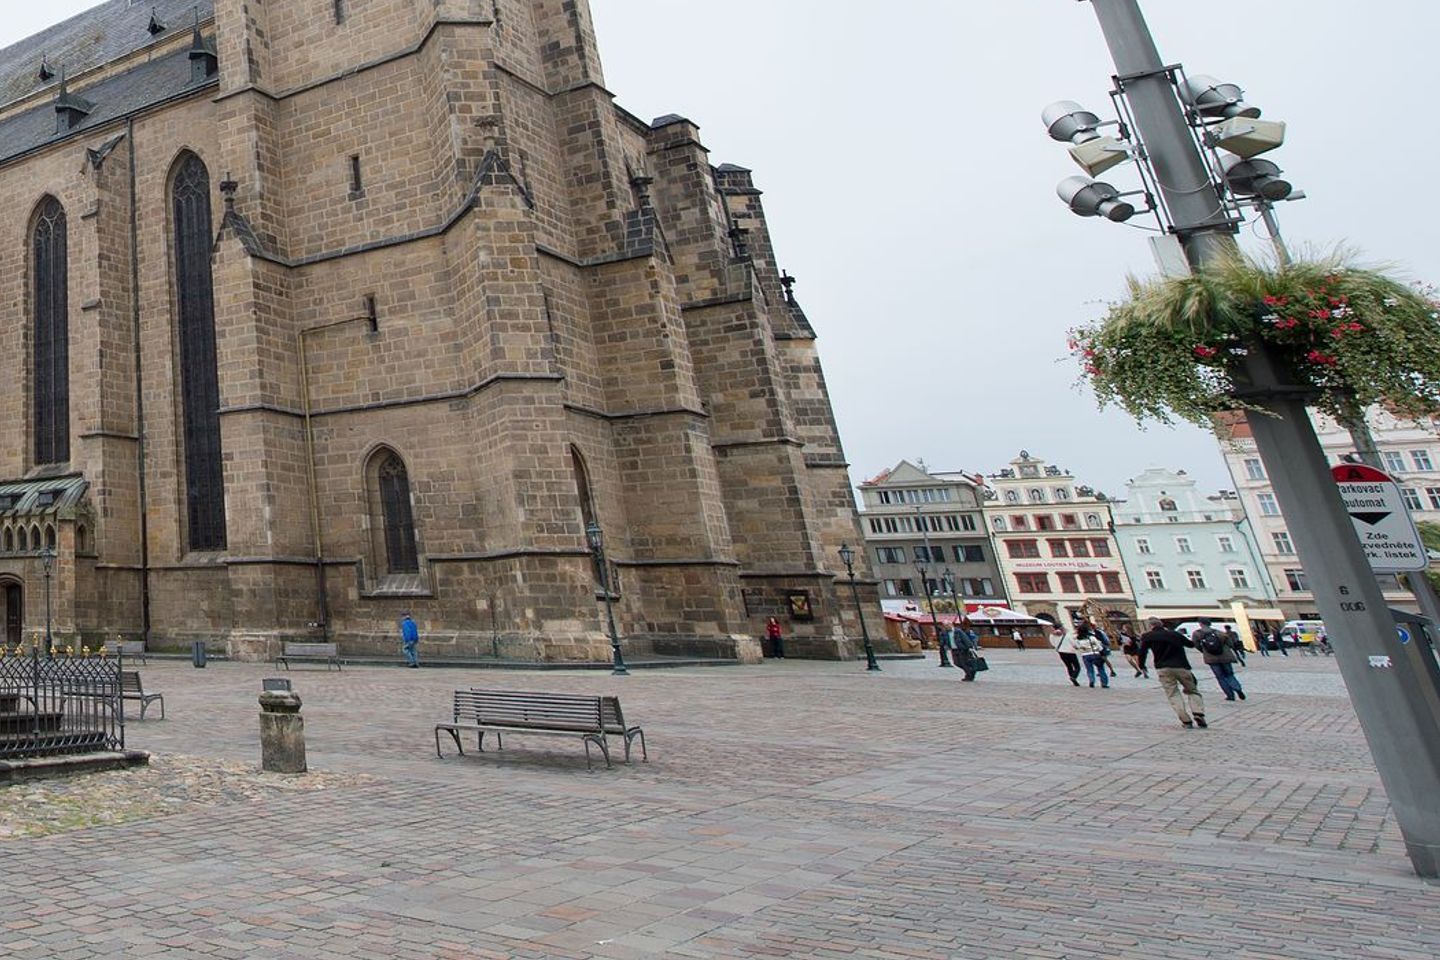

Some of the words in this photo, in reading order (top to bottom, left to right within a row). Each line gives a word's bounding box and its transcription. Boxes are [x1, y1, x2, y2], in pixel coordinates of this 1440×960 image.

[1347, 468, 1363, 479] A
[1340, 483, 1385, 494] arkovací
[1365, 532, 1389, 540] Zde
